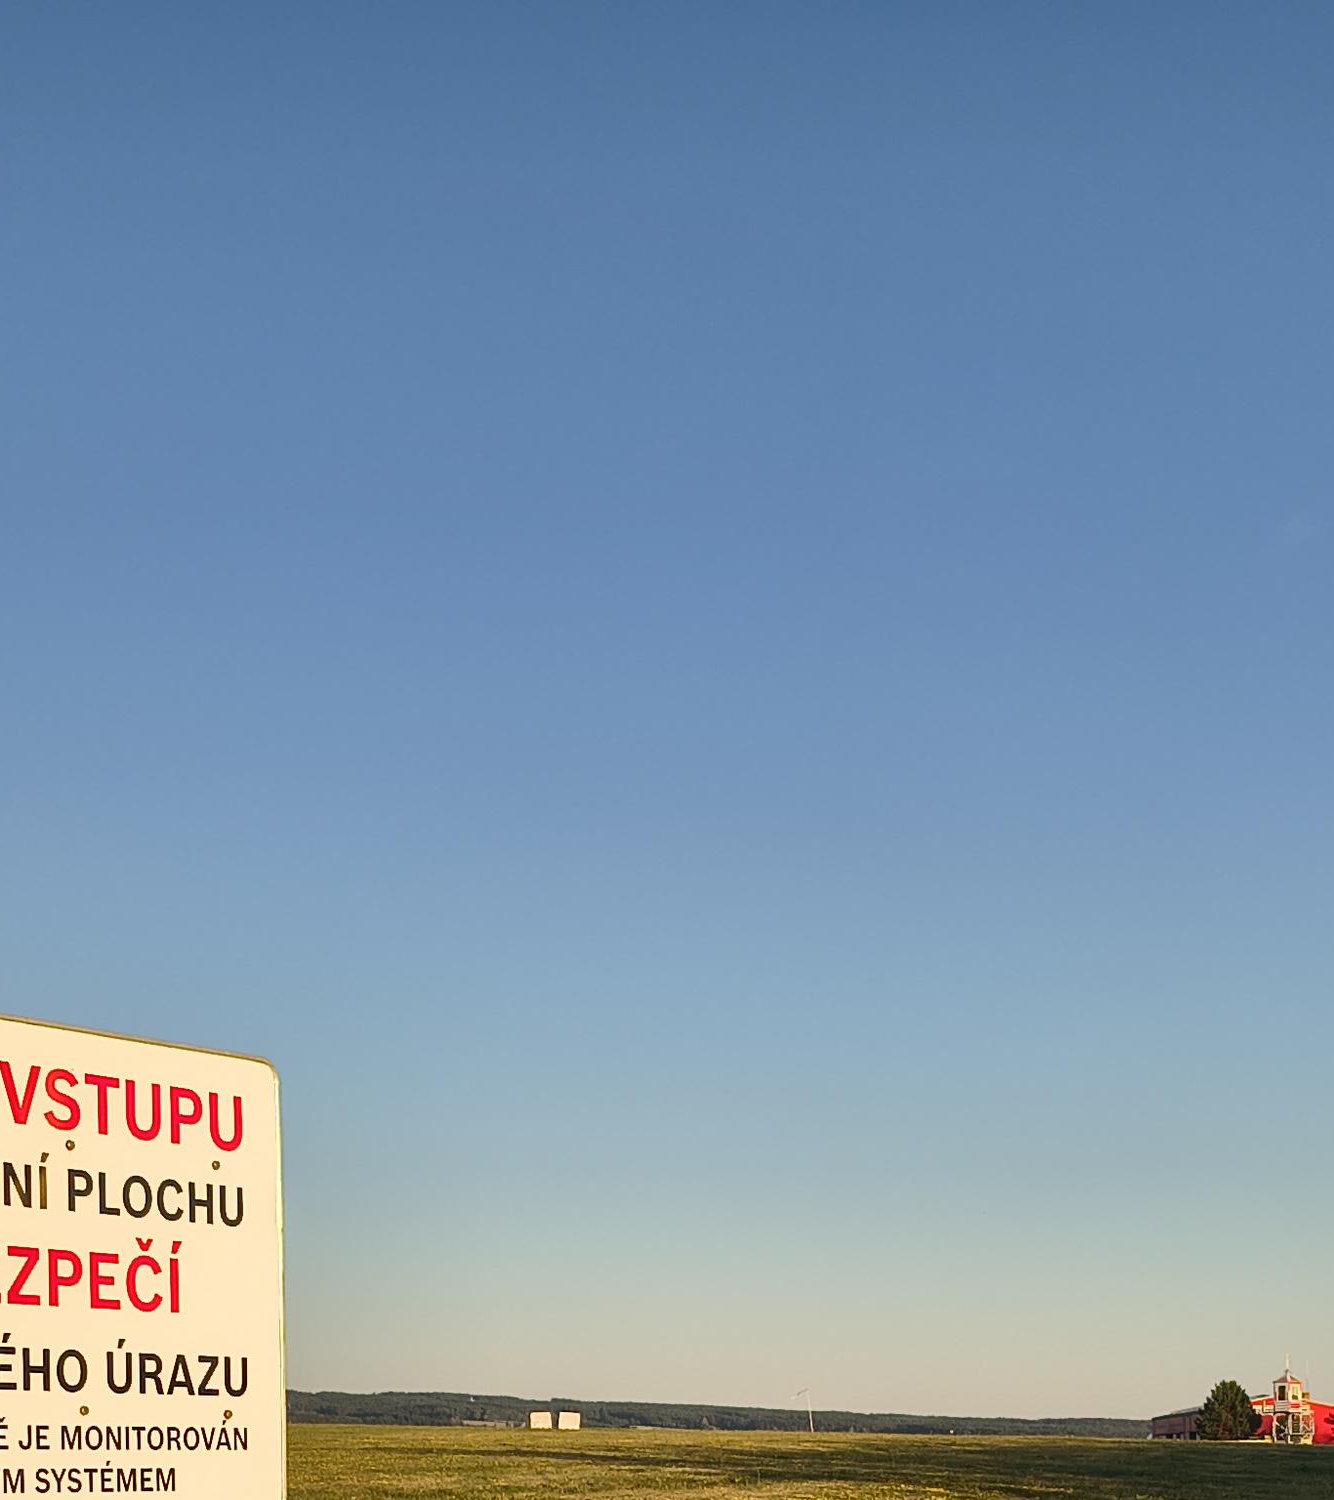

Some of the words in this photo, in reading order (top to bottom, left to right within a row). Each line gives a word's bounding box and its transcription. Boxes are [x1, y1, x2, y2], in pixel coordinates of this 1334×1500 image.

[67, 1168, 245, 1227] PLOCHU
[106, 1338, 248, 1397] ÚRAZU
[18, 1424, 51, 1451] JE
[60, 1415, 248, 1451] MONITOROVÁN
[34, 1460, 176, 1494] SYSTÉMEM
